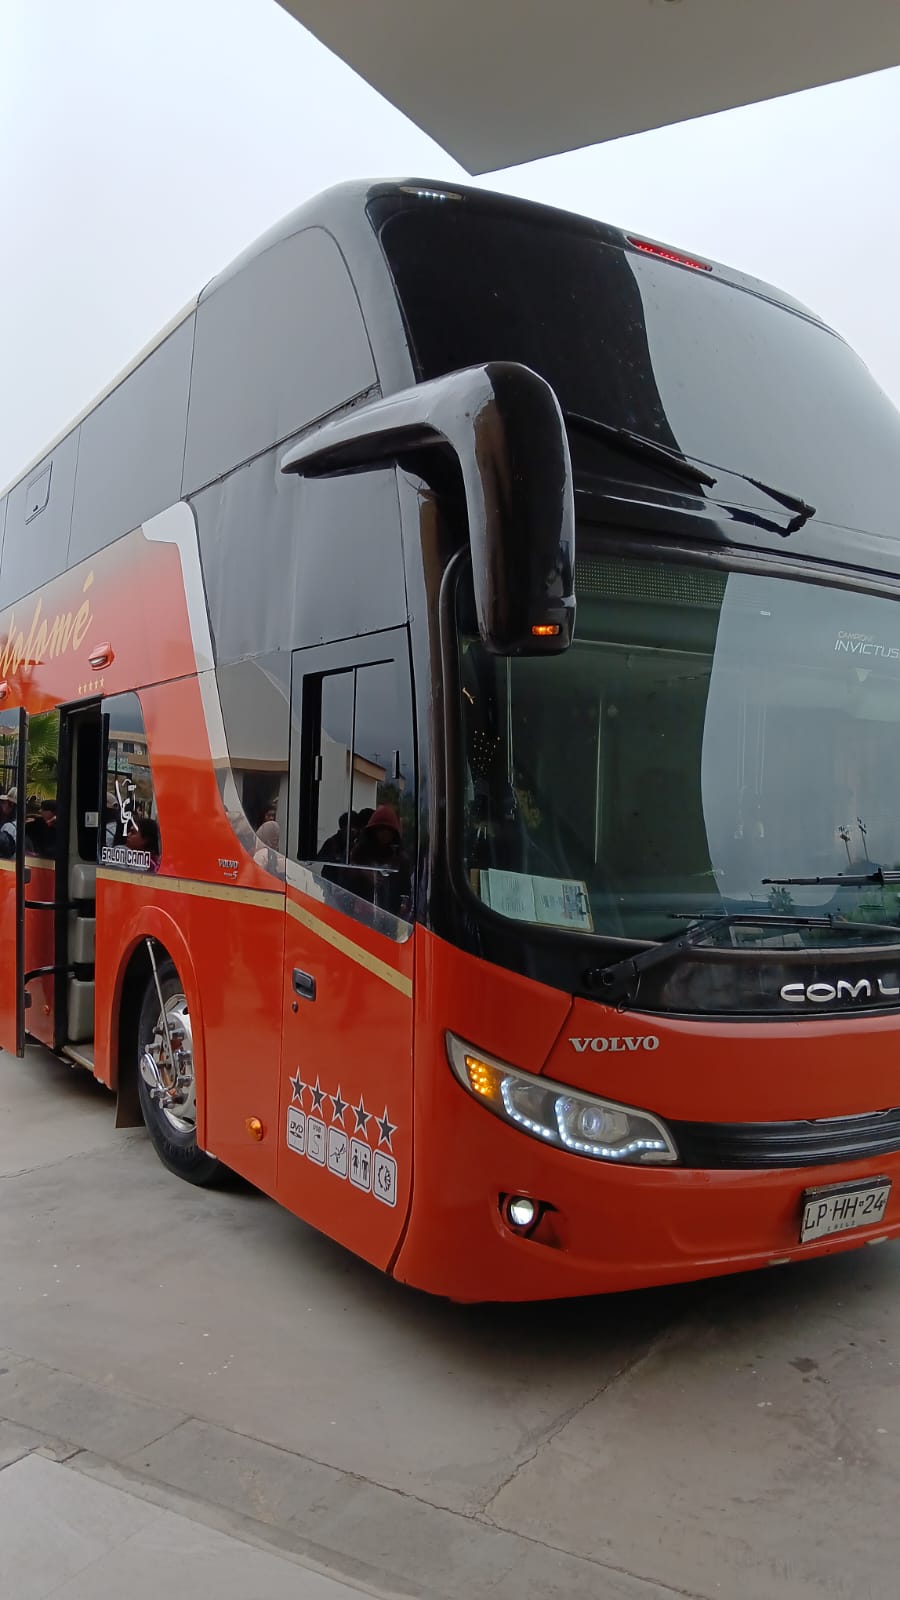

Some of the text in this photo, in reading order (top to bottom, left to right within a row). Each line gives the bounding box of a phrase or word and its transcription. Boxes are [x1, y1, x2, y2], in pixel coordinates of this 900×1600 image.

[834, 639, 900, 659] INVICTUS
[101, 846, 151, 869] SALON CAMA
[217, 858, 239, 869] VOLVO
[568, 1035, 660, 1053] VOLVO
[290, 1120, 304, 1134] DVD
